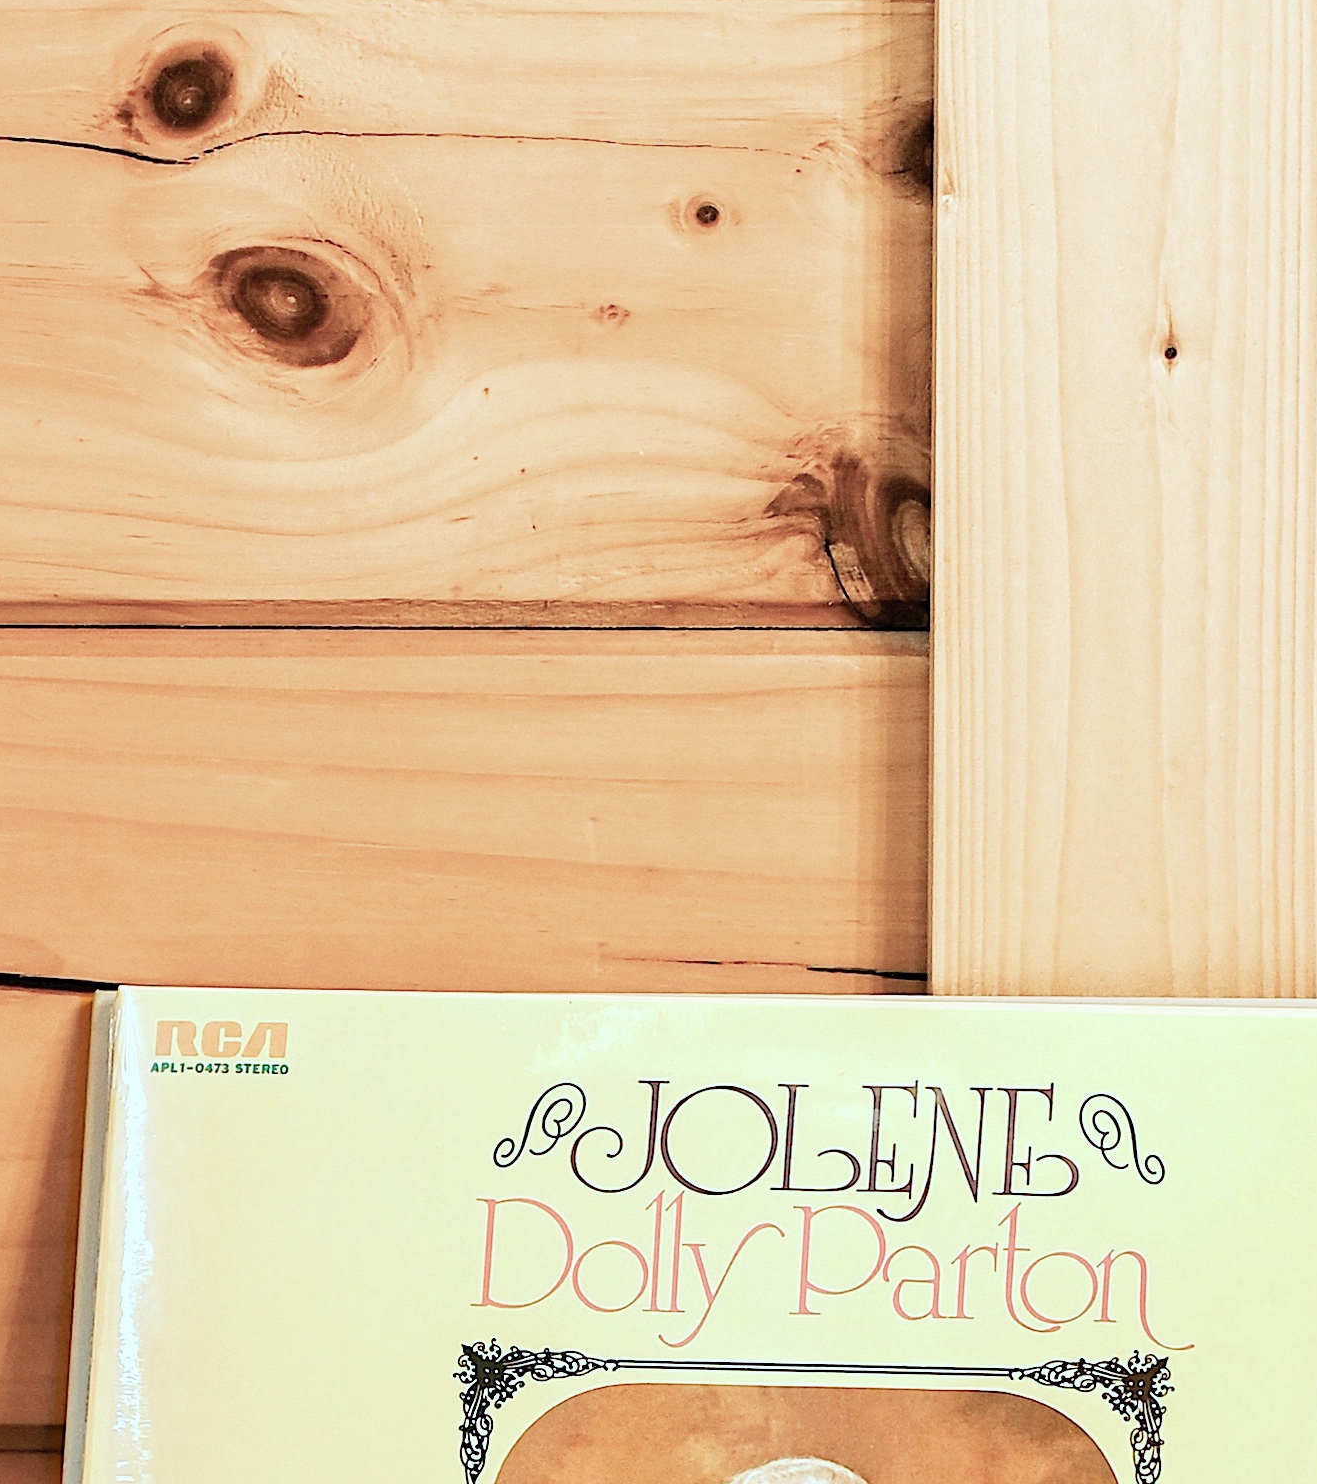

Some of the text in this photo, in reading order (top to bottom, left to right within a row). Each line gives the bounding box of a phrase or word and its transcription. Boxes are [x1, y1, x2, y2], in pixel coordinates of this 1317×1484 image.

[150, 1063, 289, 1075] APL1-0473 STEREO
[155, 1020, 288, 1058] RCA
[570, 1079, 1080, 1222] JOLENE
[470, 1189, 1195, 1352] Dolly Parton
